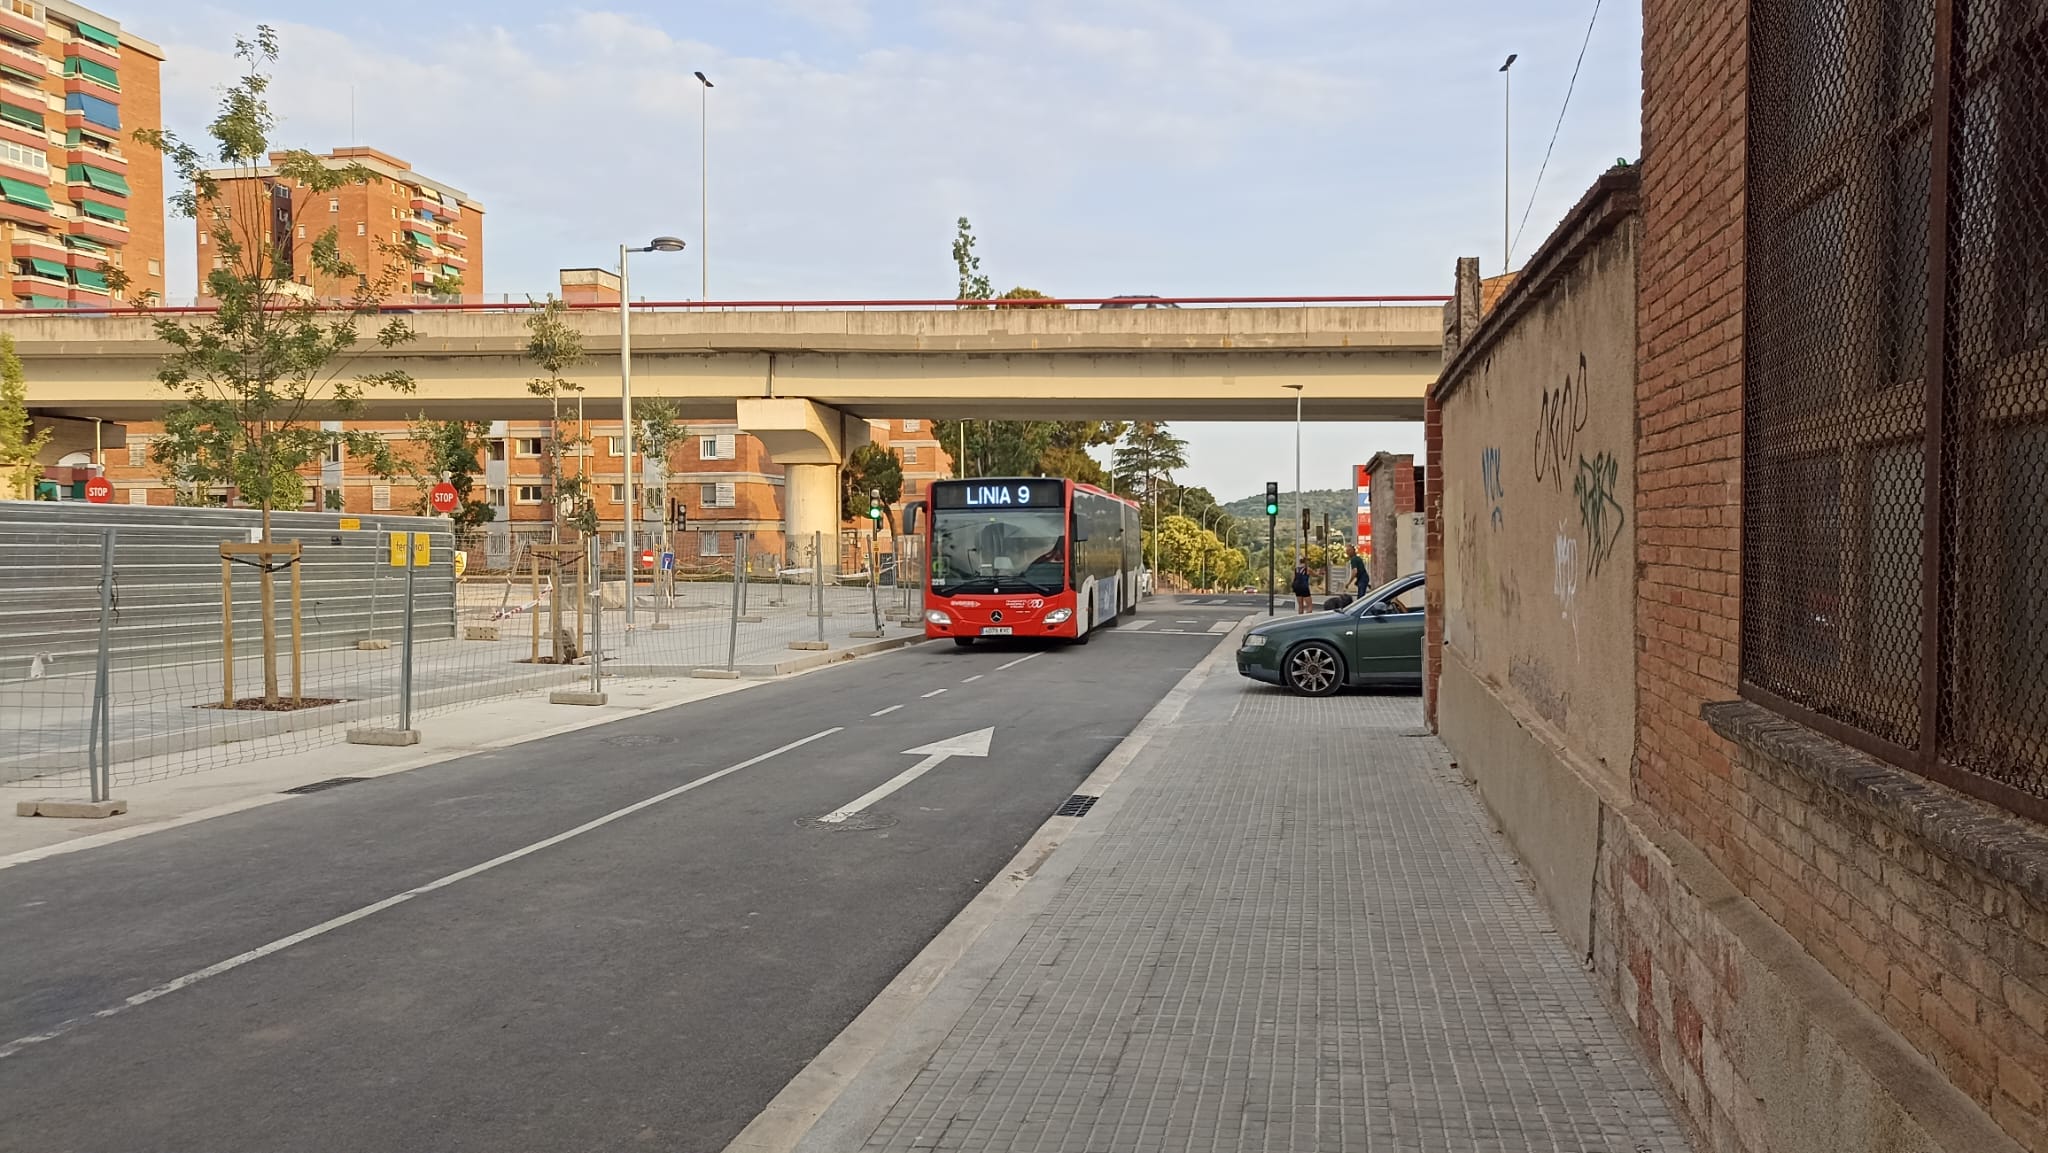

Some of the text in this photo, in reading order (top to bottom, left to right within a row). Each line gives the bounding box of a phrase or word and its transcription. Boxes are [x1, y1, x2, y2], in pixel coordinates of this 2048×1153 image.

[89, 487, 108, 497] STOP
[434, 492, 454, 503] STOP
[1018, 485, 1030, 504] 9
